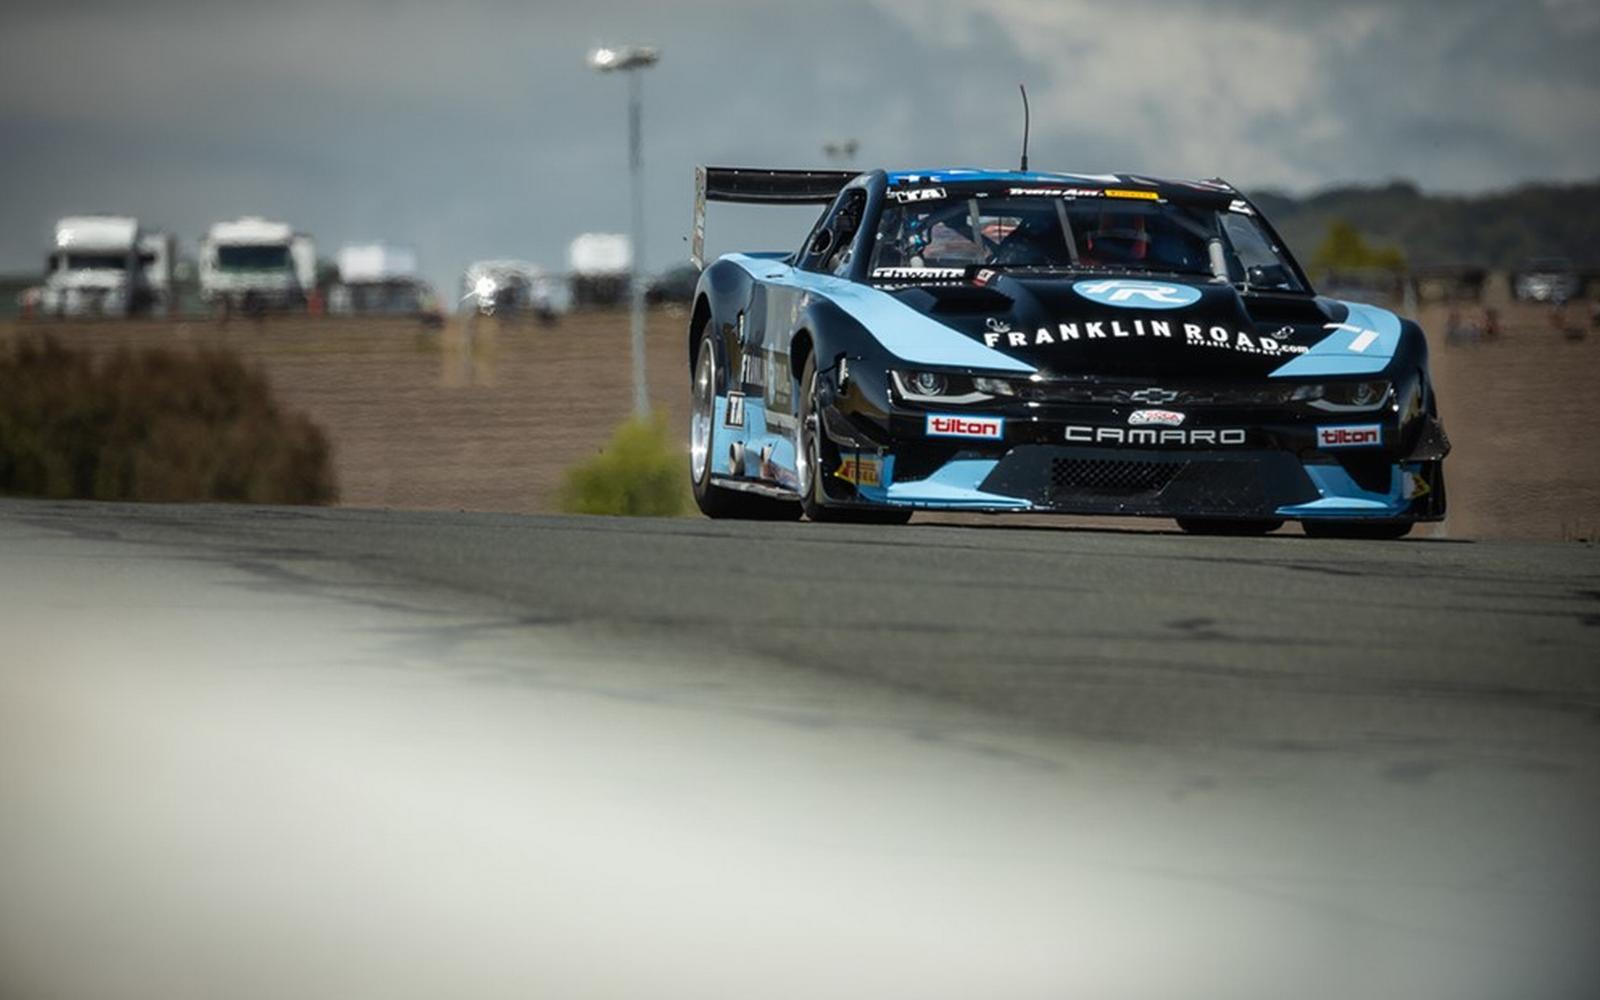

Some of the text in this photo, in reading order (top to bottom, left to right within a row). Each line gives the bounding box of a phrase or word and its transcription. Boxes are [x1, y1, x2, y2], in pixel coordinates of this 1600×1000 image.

[983, 319, 1171, 347] FRANKLIN
[931, 418, 997, 435] tilton
[1065, 426, 1246, 445] CAMARO
[1322, 429, 1377, 444] tilton
